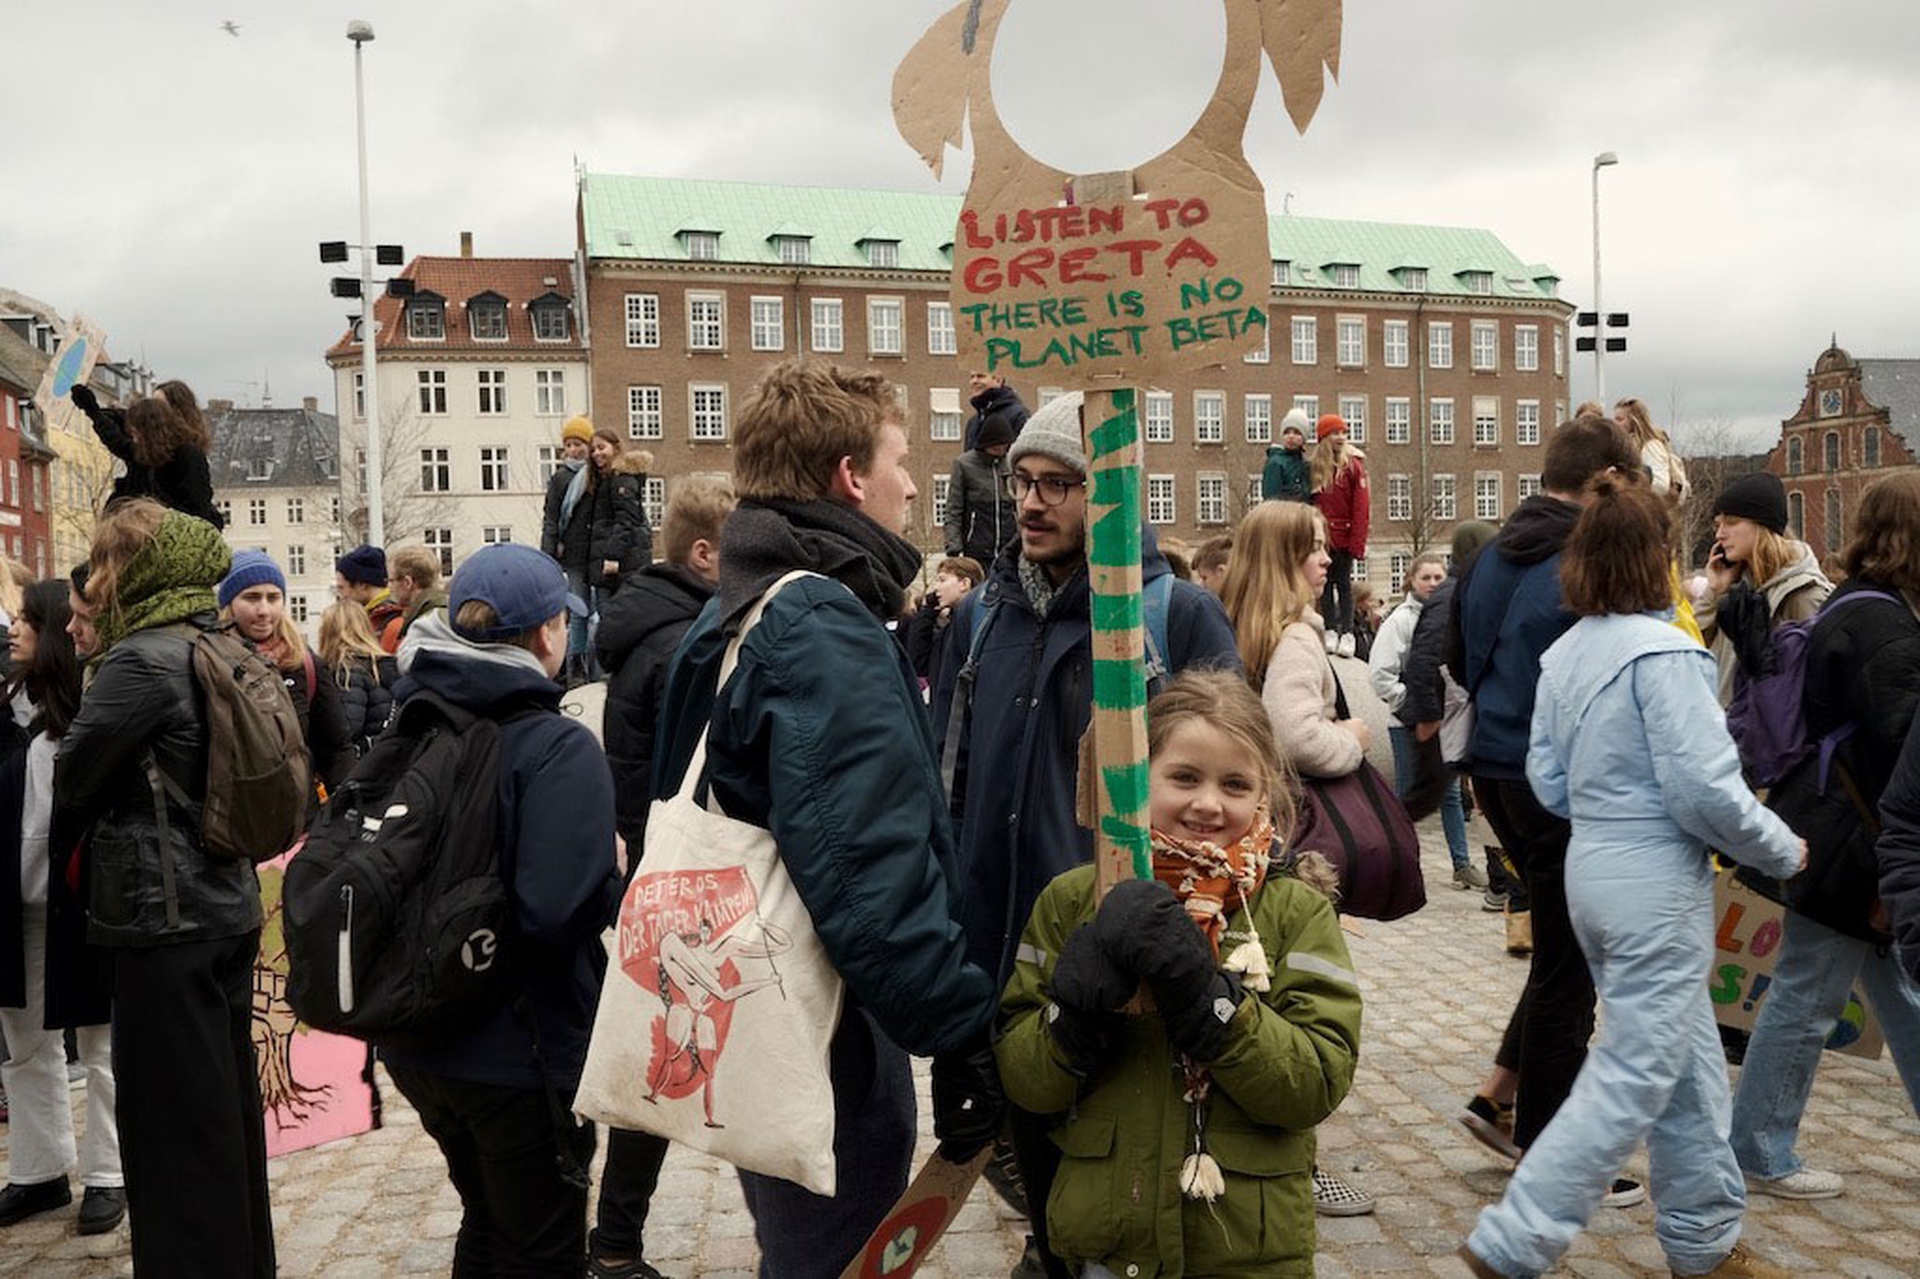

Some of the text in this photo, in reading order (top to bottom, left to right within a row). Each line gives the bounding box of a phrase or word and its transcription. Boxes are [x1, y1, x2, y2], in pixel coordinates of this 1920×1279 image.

[960, 198, 1210, 248] LISTEN TO
[963, 237, 1218, 294] GRETA
[960, 277, 1244, 333] THERE IS NO
[984, 306, 1268, 373] PLANET BETA
